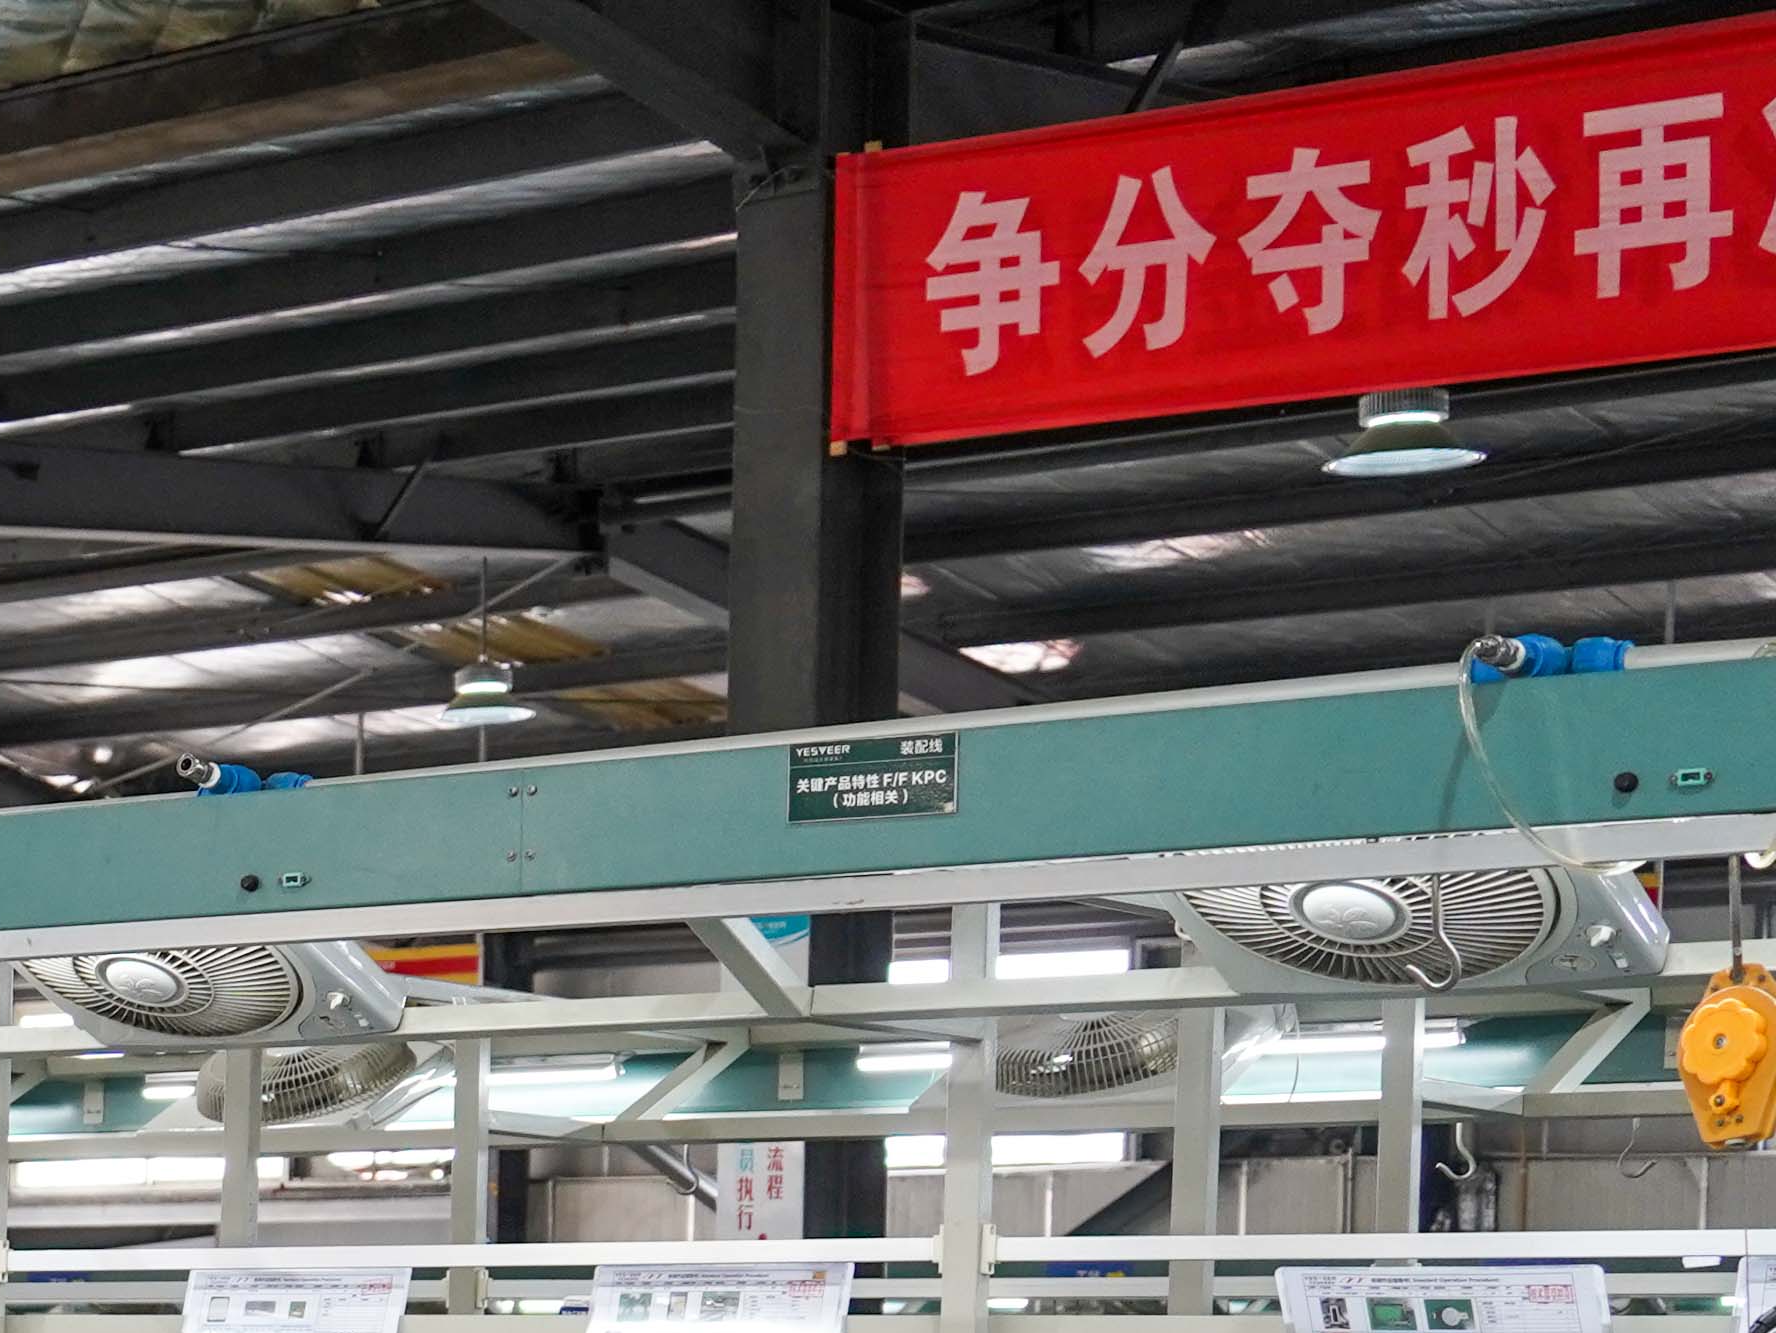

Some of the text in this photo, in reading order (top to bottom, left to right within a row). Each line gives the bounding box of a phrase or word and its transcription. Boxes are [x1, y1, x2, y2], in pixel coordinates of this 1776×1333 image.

[925, 92, 1776, 377] 争分夺秒再
[795, 744, 851, 758] YESVEER
[900, 738, 943, 755] 装配线
[797, 769, 947, 794] 关键产品特性 F/F KPC
